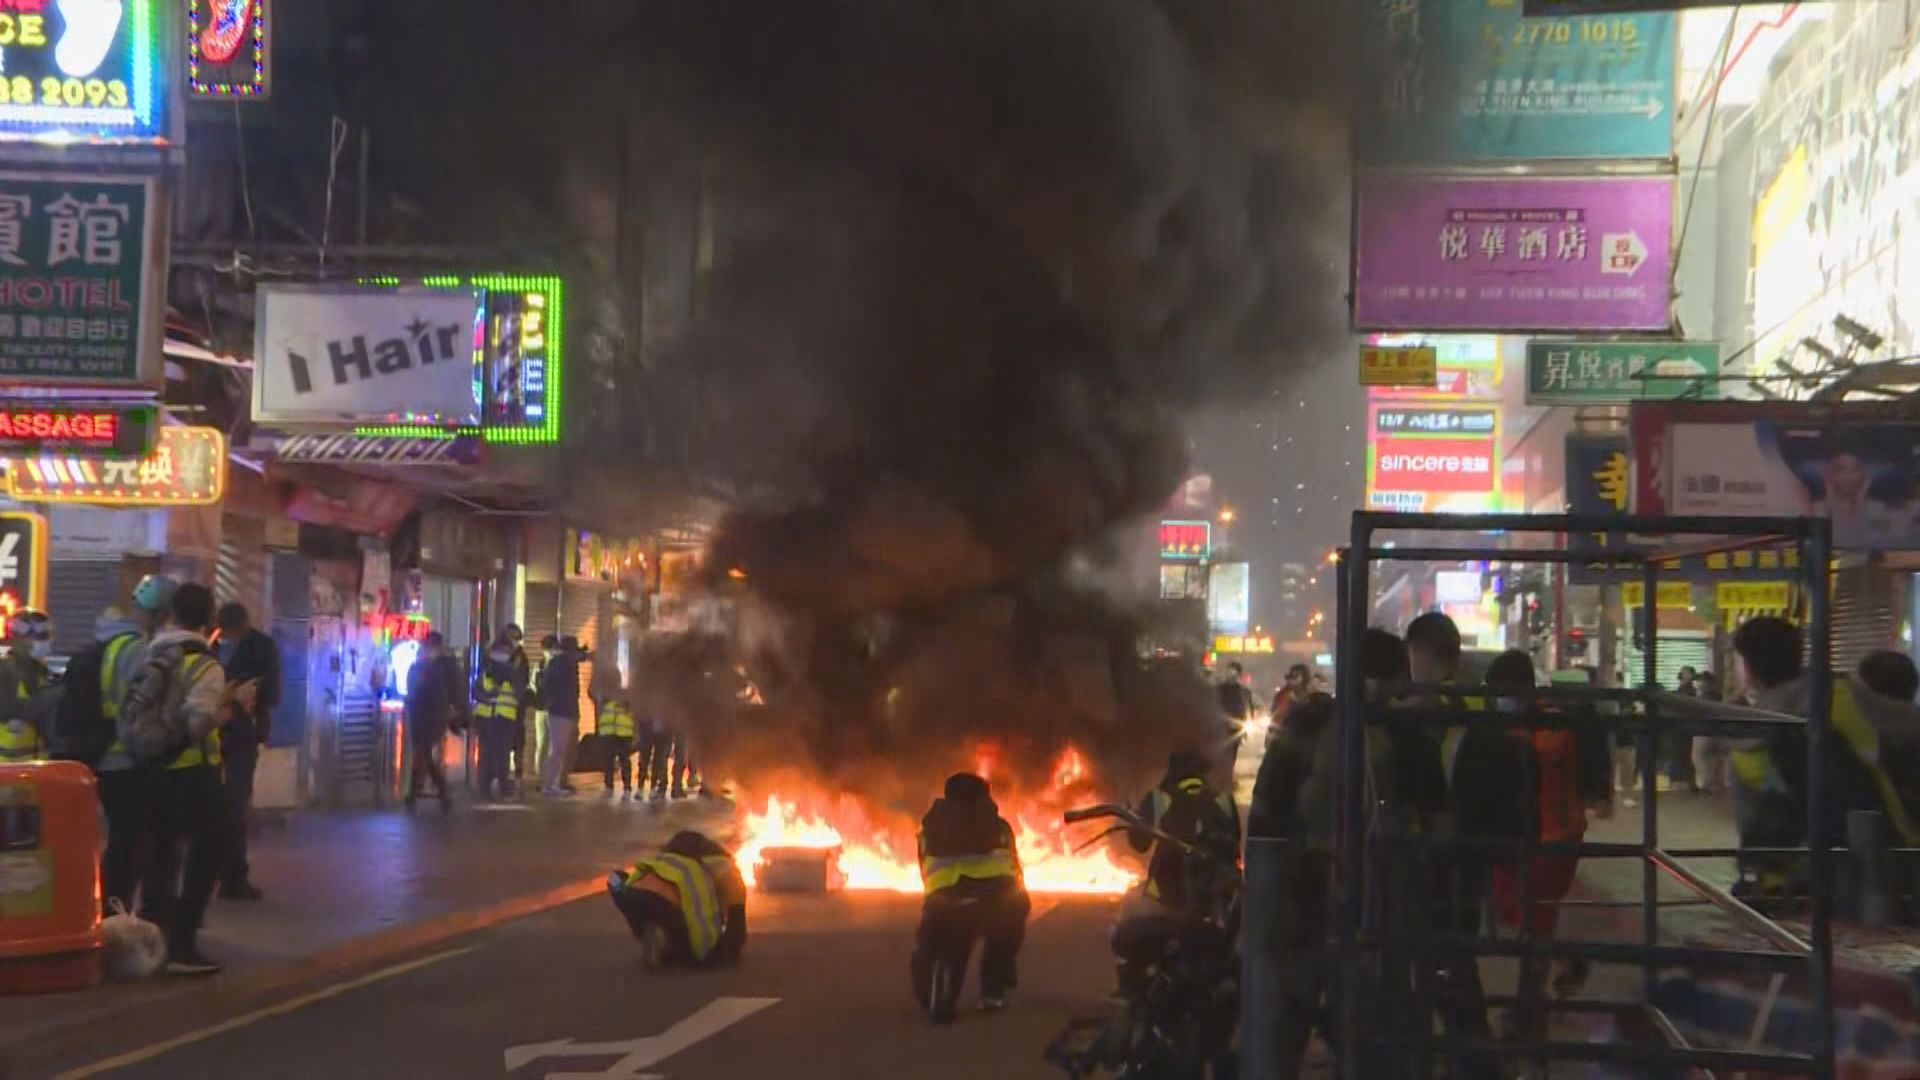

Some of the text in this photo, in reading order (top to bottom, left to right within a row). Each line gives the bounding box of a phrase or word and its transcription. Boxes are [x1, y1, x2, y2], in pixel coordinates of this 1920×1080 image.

[41, 77, 128, 108] 2093
[327, 318, 462, 384] Hair
[1381, 454, 1460, 473] sincere
